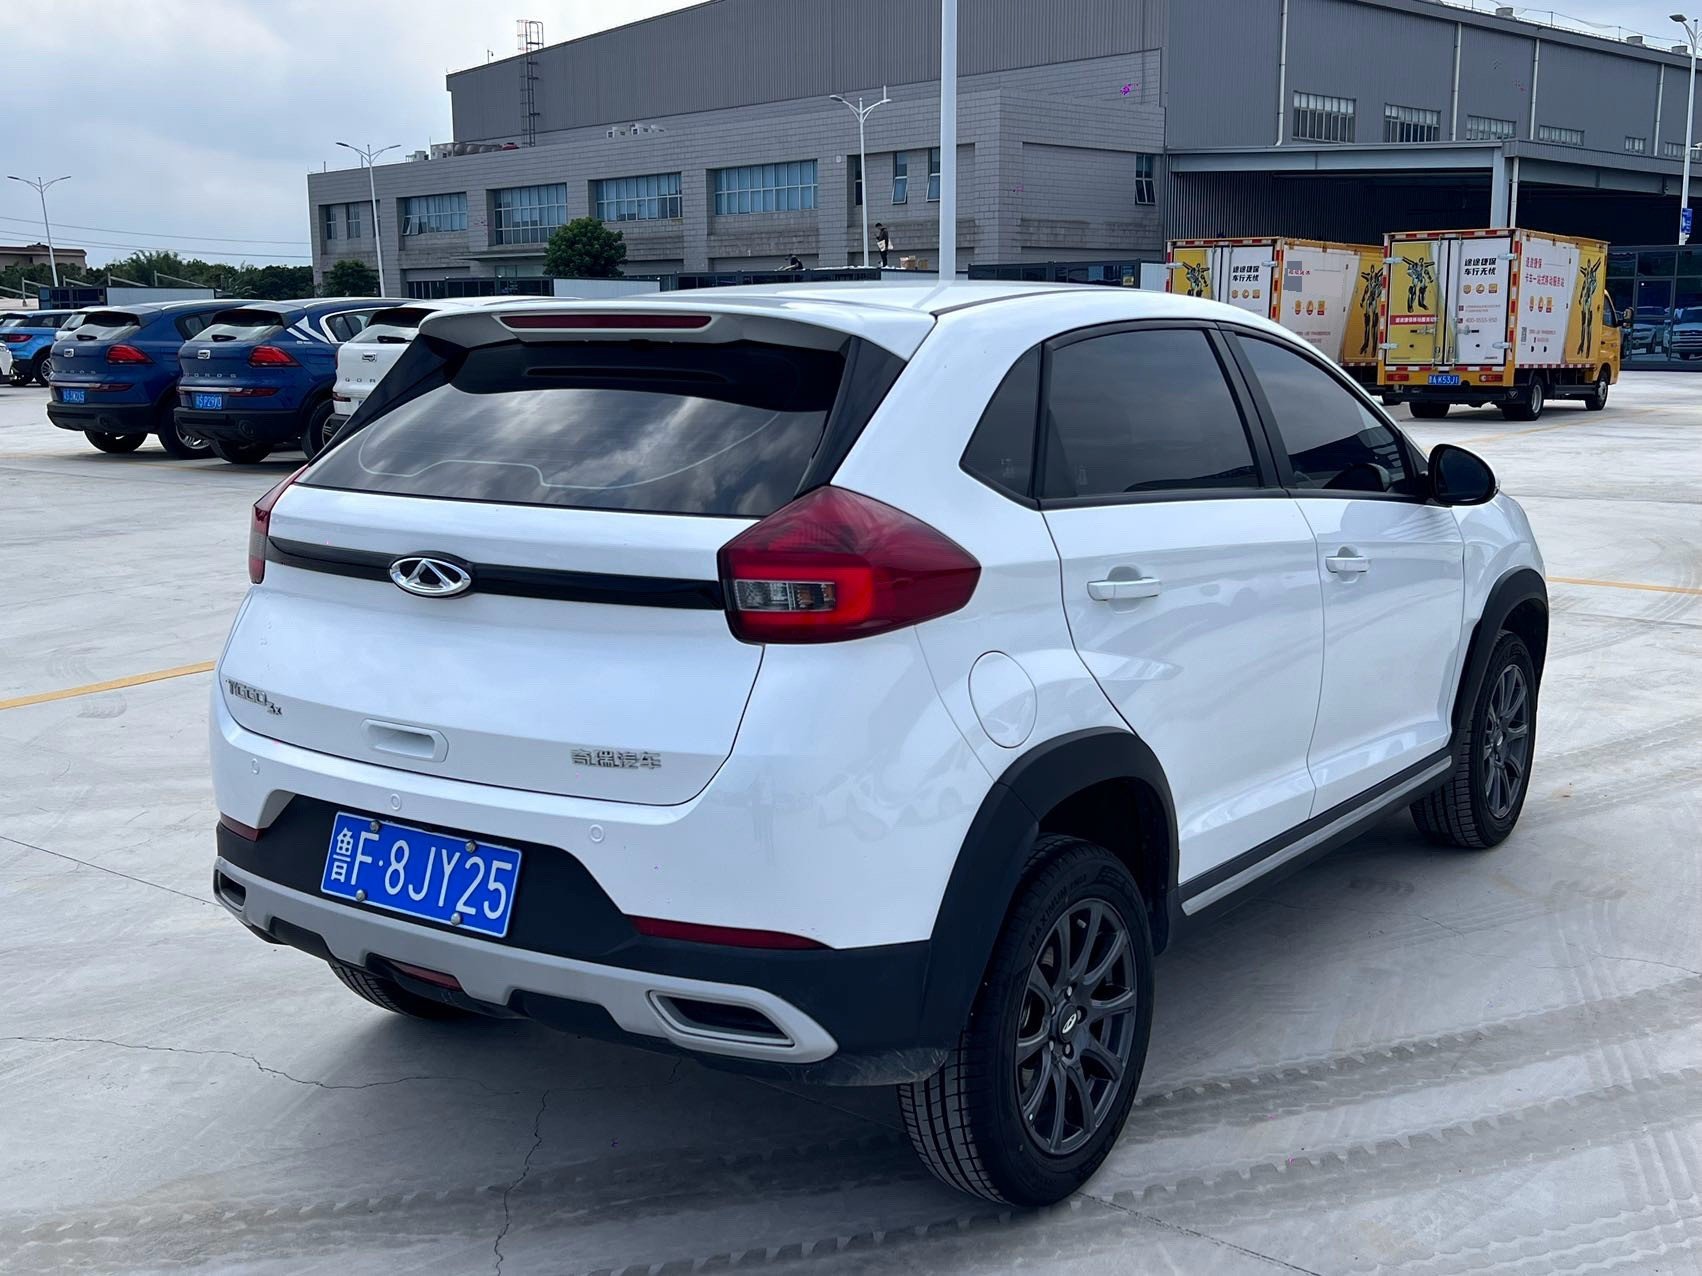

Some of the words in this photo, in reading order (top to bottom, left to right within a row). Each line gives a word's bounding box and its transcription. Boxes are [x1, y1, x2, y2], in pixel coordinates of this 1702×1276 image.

[225, 679, 267, 706] TIGGO
[571, 749, 662, 769] 奇瑞汽车
